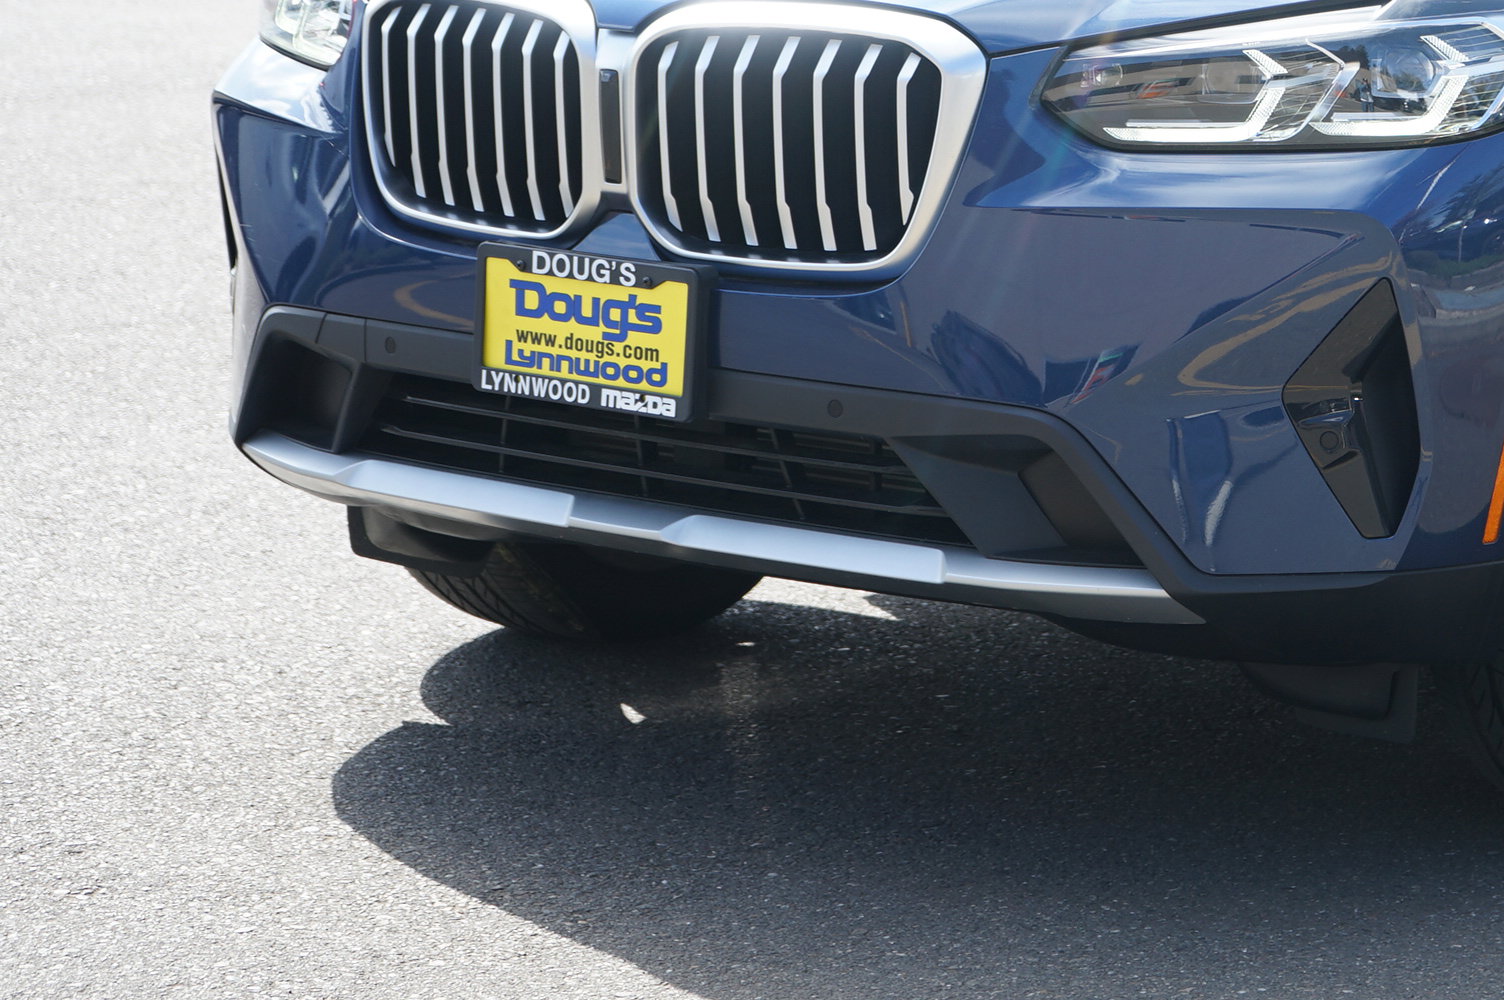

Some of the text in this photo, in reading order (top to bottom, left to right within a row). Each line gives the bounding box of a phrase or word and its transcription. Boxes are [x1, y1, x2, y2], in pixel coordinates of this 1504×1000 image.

[531, 250, 637, 287] DOUG'S
[509, 278, 662, 343] Doug's
[505, 339, 668, 388] Lynnwood
[516, 329, 660, 363] www.dougs.com
[481, 369, 590, 405] LYNNWOOD
